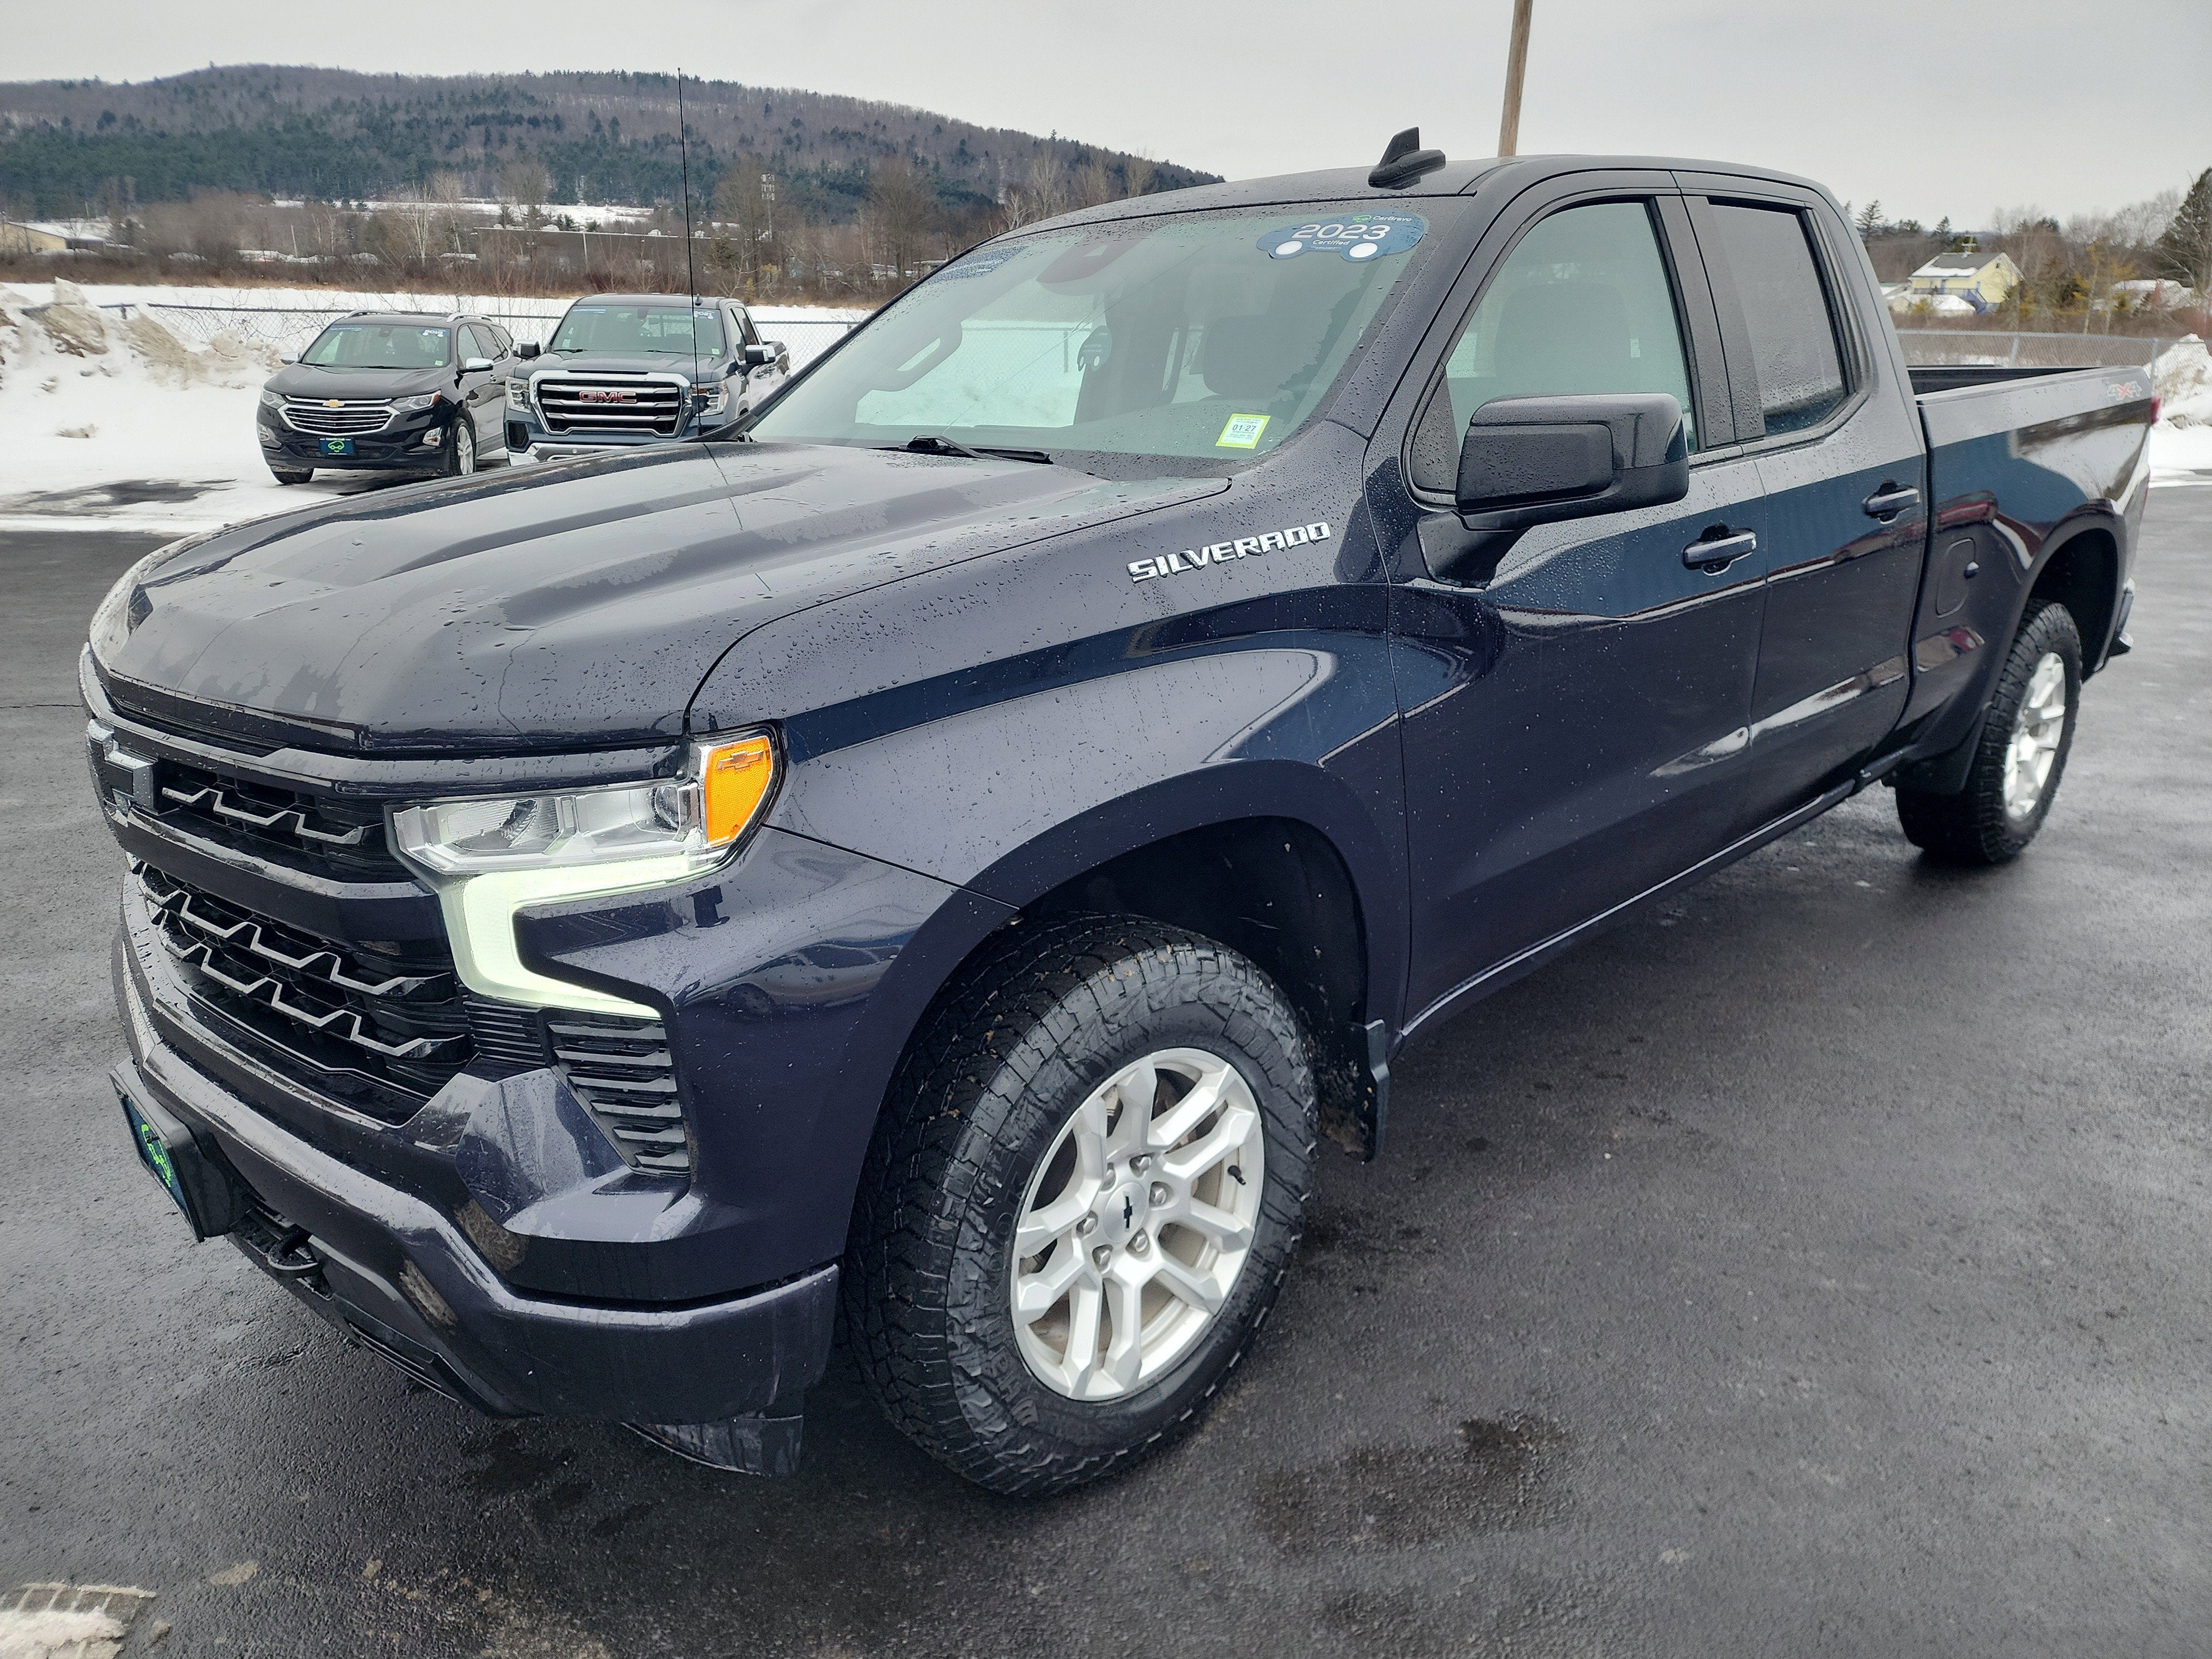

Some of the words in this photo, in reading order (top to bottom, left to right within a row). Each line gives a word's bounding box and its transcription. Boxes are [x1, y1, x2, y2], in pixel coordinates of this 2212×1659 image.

[1291, 223, 1391, 240] 2023
[578, 390, 637, 403] GMC
[1127, 521, 1331, 583] SILVERADO
